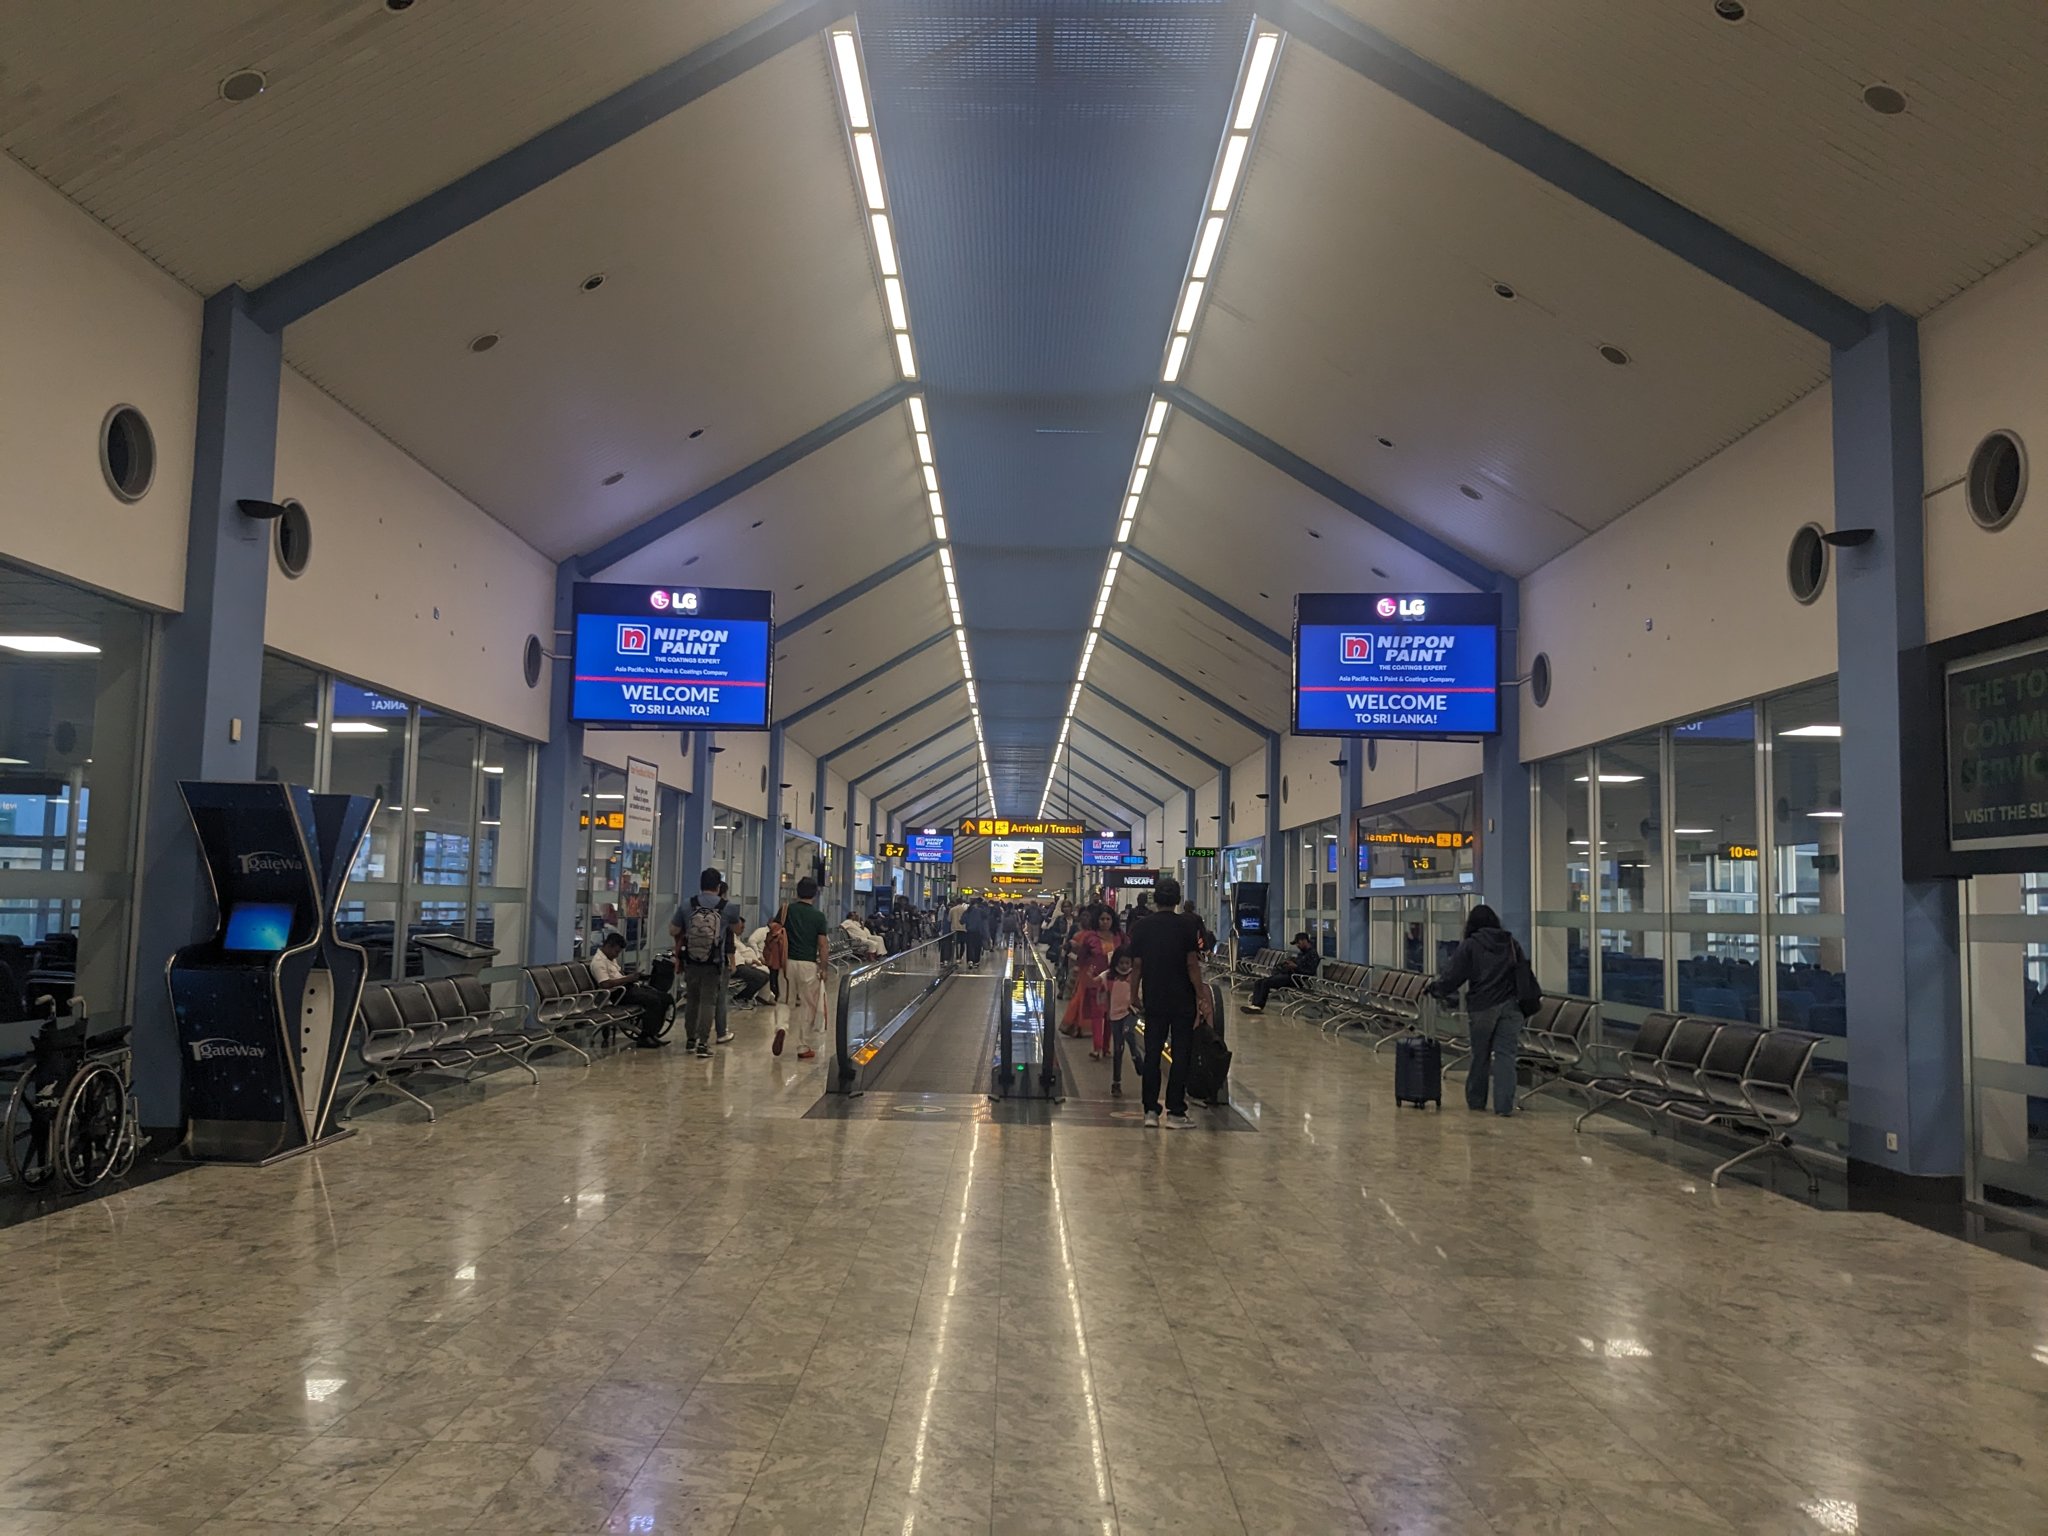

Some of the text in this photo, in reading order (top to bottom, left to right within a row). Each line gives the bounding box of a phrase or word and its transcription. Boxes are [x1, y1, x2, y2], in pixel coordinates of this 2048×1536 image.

[672, 592, 697, 609] LG
[1399, 599, 1425, 616] LG
[653, 627, 729, 642] NIPPON
[661, 641, 720, 655] PAINT
[1377, 636, 1455, 648] NIPPON
[667, 656, 697, 664] COATINGS
[1385, 649, 1446, 662] PAINT
[703, 669, 728, 677] Company
[621, 684, 720, 703] WELCOME
[1962, 668, 2048, 711] THE TO
[1346, 694, 1448, 710] WELCOME
[629, 704, 710, 716] TO SRI LANKA!
[1355, 714, 1438, 724] TO SRI LANKA!
[1964, 807, 1996, 824] VISIT
[1998, 804, 2027, 822] THE
[1011, 824, 1084, 834] Arrival / Transit
[886, 847, 904, 856] 6-7
[1729, 846, 1742, 858] 10
